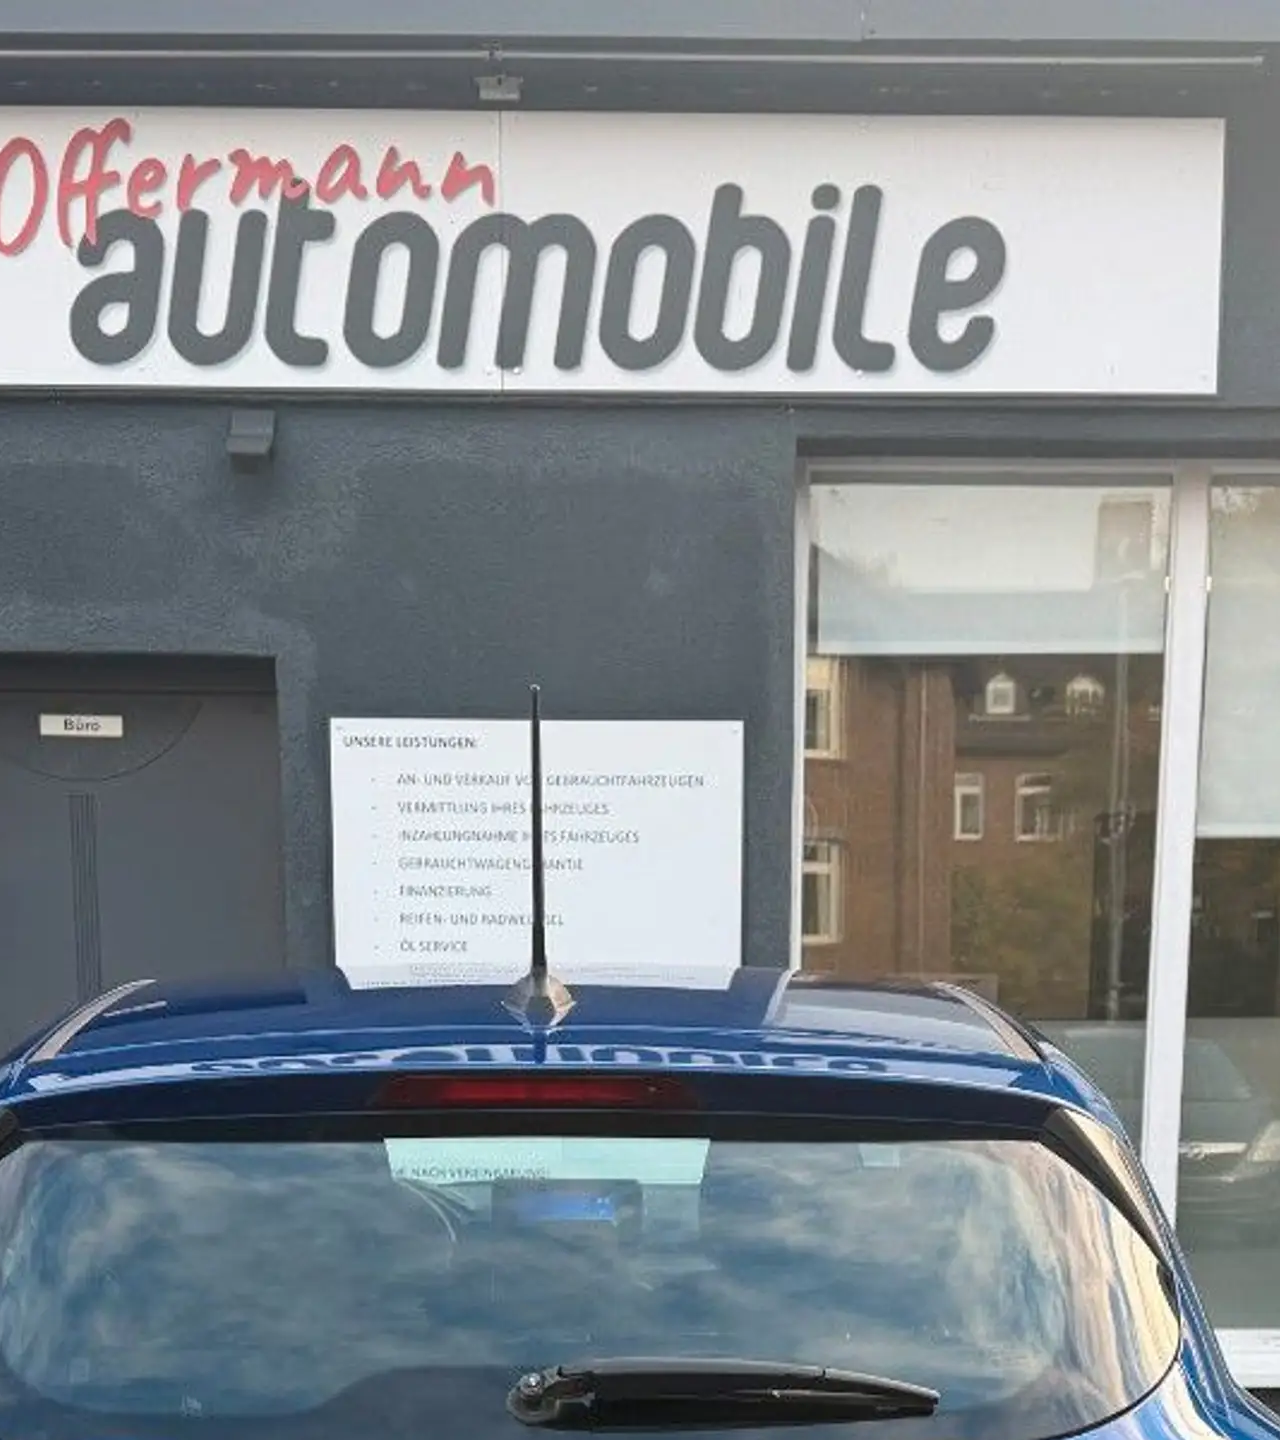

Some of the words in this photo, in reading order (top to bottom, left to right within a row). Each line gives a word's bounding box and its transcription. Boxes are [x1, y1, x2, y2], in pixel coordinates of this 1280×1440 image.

[69, 183, 1007, 373] automobile
[343, 735, 392, 749] UNSERE
[423, 773, 451, 787] UND
[454, 773, 511, 787] VERKAUF
[547, 774, 705, 789] GEBRAUCHTFAHRZEUGEN
[397, 801, 488, 815] VERMITTLUNG
[560, 830, 639, 844] FAHRZEUGES
[399, 884, 492, 898] FINANZIERUNG
[450, 913, 478, 927] UND
[420, 940, 468, 952] SERVICE
